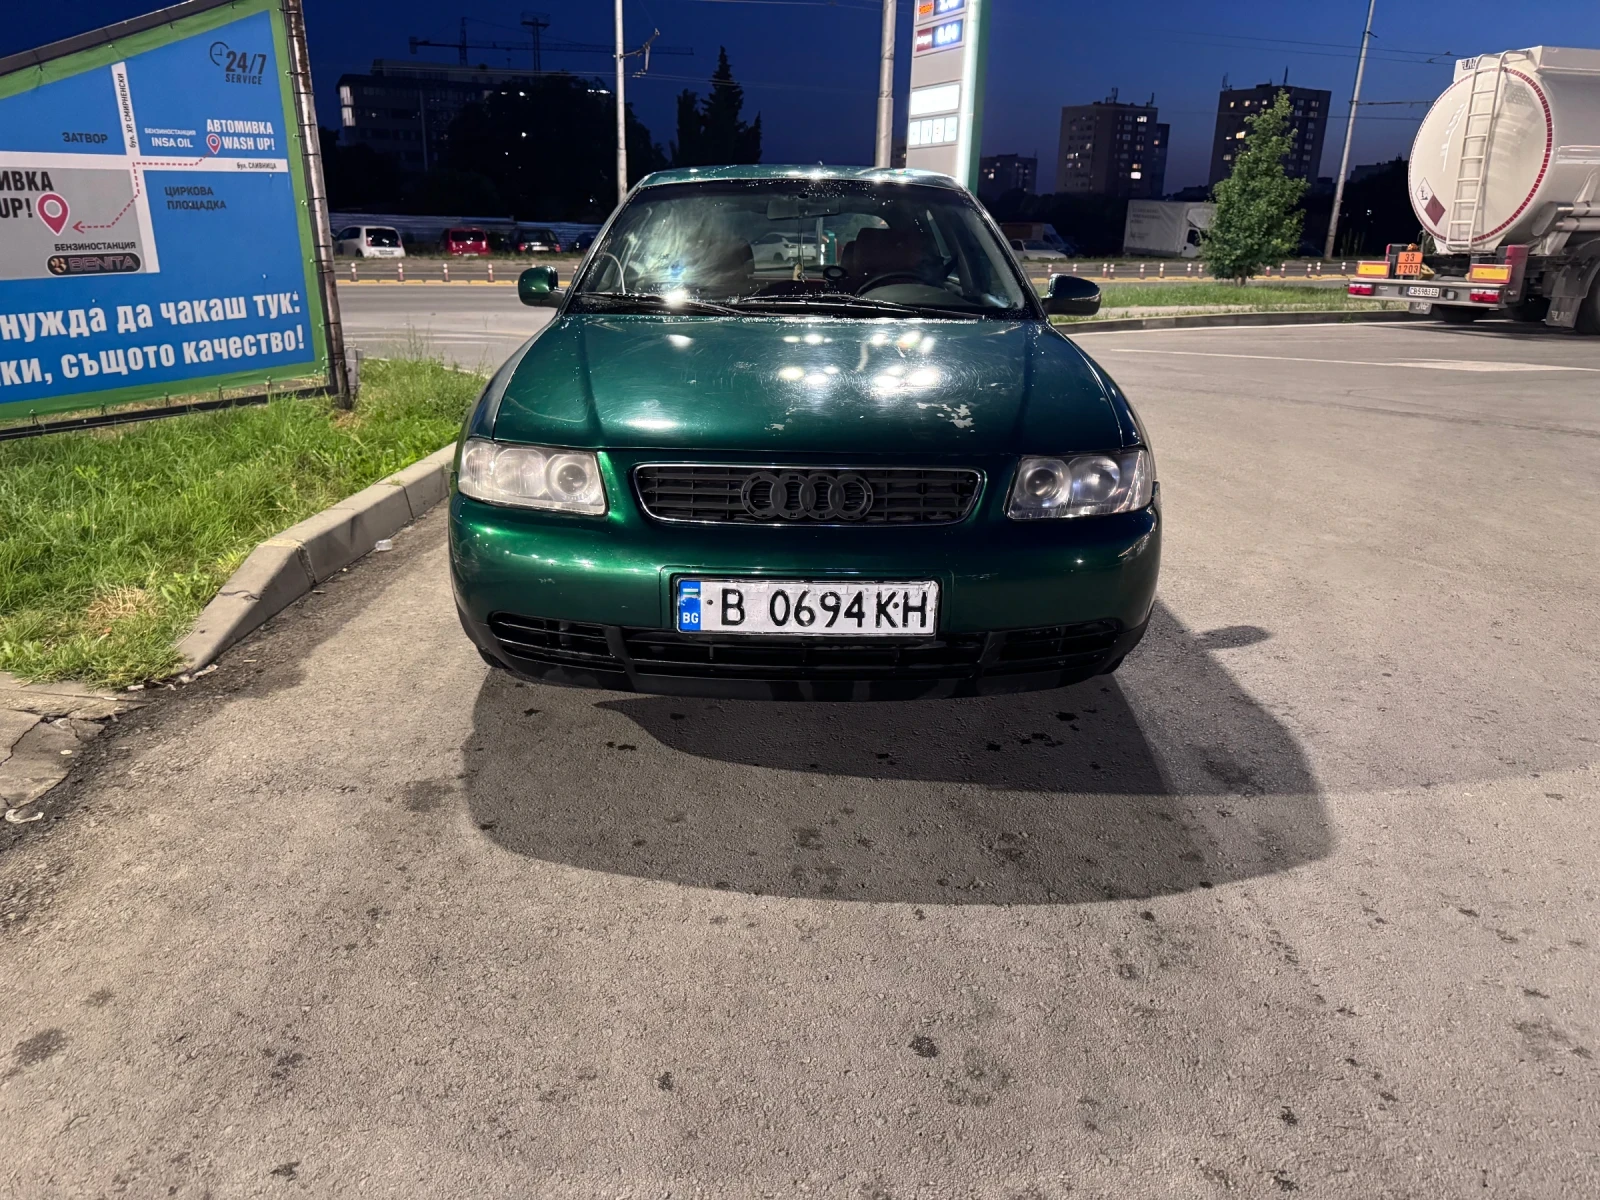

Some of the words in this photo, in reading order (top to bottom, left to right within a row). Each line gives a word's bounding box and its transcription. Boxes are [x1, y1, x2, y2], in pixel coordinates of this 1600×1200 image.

[225, 50, 267, 75] 24/7
[225, 73, 263, 85] SERVICE
[117, 73, 132, 122] СМИРНЕНСКИ
[144, 128, 196, 136] БЕНЗИНОСТАНЦИЯ
[206, 119, 274, 135] АВТОМИВКА
[62, 132, 108, 145] ЗАТВОР
[151, 137, 176, 147] INSA
[177, 138, 193, 148] OIL
[222, 136, 255, 150] WASH
[257, 137, 275, 151] UP!
[249, 162, 277, 170] СЛИВНИЦА
[164, 186, 214, 197] ЦИРКОВА
[0, 197, 33, 219] UP!
[167, 200, 227, 211] ПЛОЩАДКА
[54, 242, 136, 252] БЕНЗИНОСТАНЦИЯ
[68, 255, 138, 272] BENITA
[1404, 253, 1415, 262] 33
[1398, 264, 1419, 274] 1203
[0, 307, 107, 343] нужда
[116, 304, 153, 334] да
[160, 296, 247, 325] чакаш
[253, 292, 301, 319] тук:
[0, 357, 53, 385] ки,
[61, 344, 176, 379] същото
[182, 325, 305, 365] качество!
[721, 588, 745, 626] B
[682, 612, 699, 624] BG
